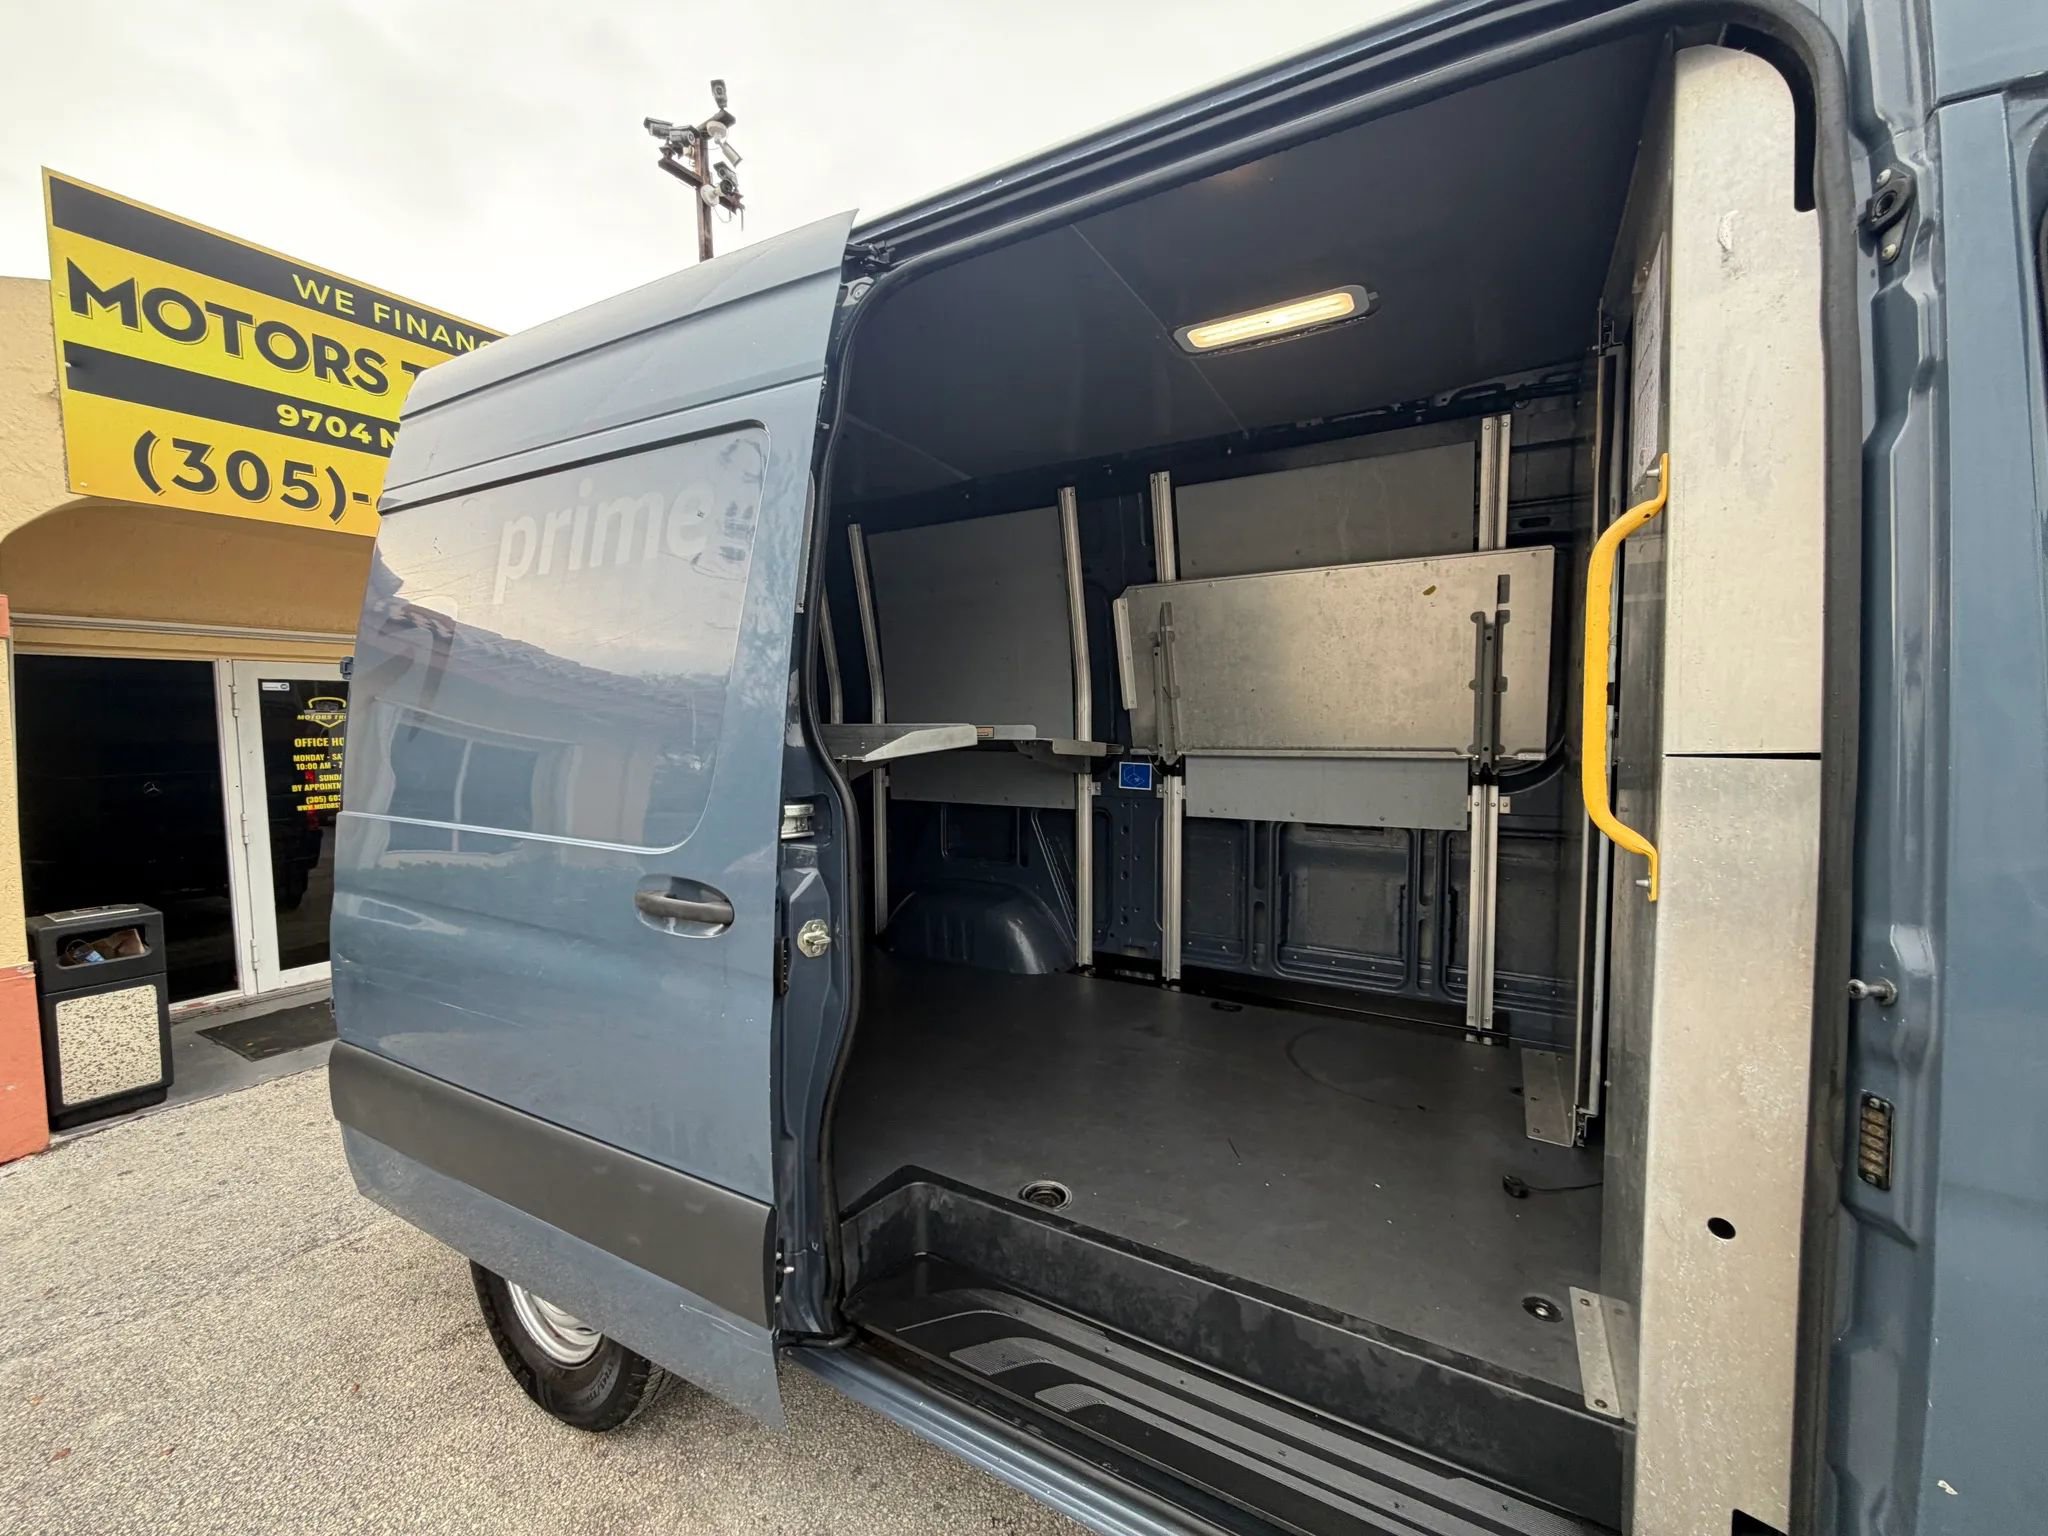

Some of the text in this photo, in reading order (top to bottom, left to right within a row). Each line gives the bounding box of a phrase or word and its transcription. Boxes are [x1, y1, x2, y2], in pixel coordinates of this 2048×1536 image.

[291, 273, 356, 316] WE
[66, 256, 391, 397] MOTORS
[275, 403, 374, 445] 9704
[492, 478, 714, 606] prime
[294, 737, 330, 748] OFFICE
[293, 753, 325, 762] MONDAY
[296, 763, 318, 771] 10:00
[319, 762, 332, 770] AM
[291, 784, 303, 792] BY
[306, 795, 327, 805] (305)
